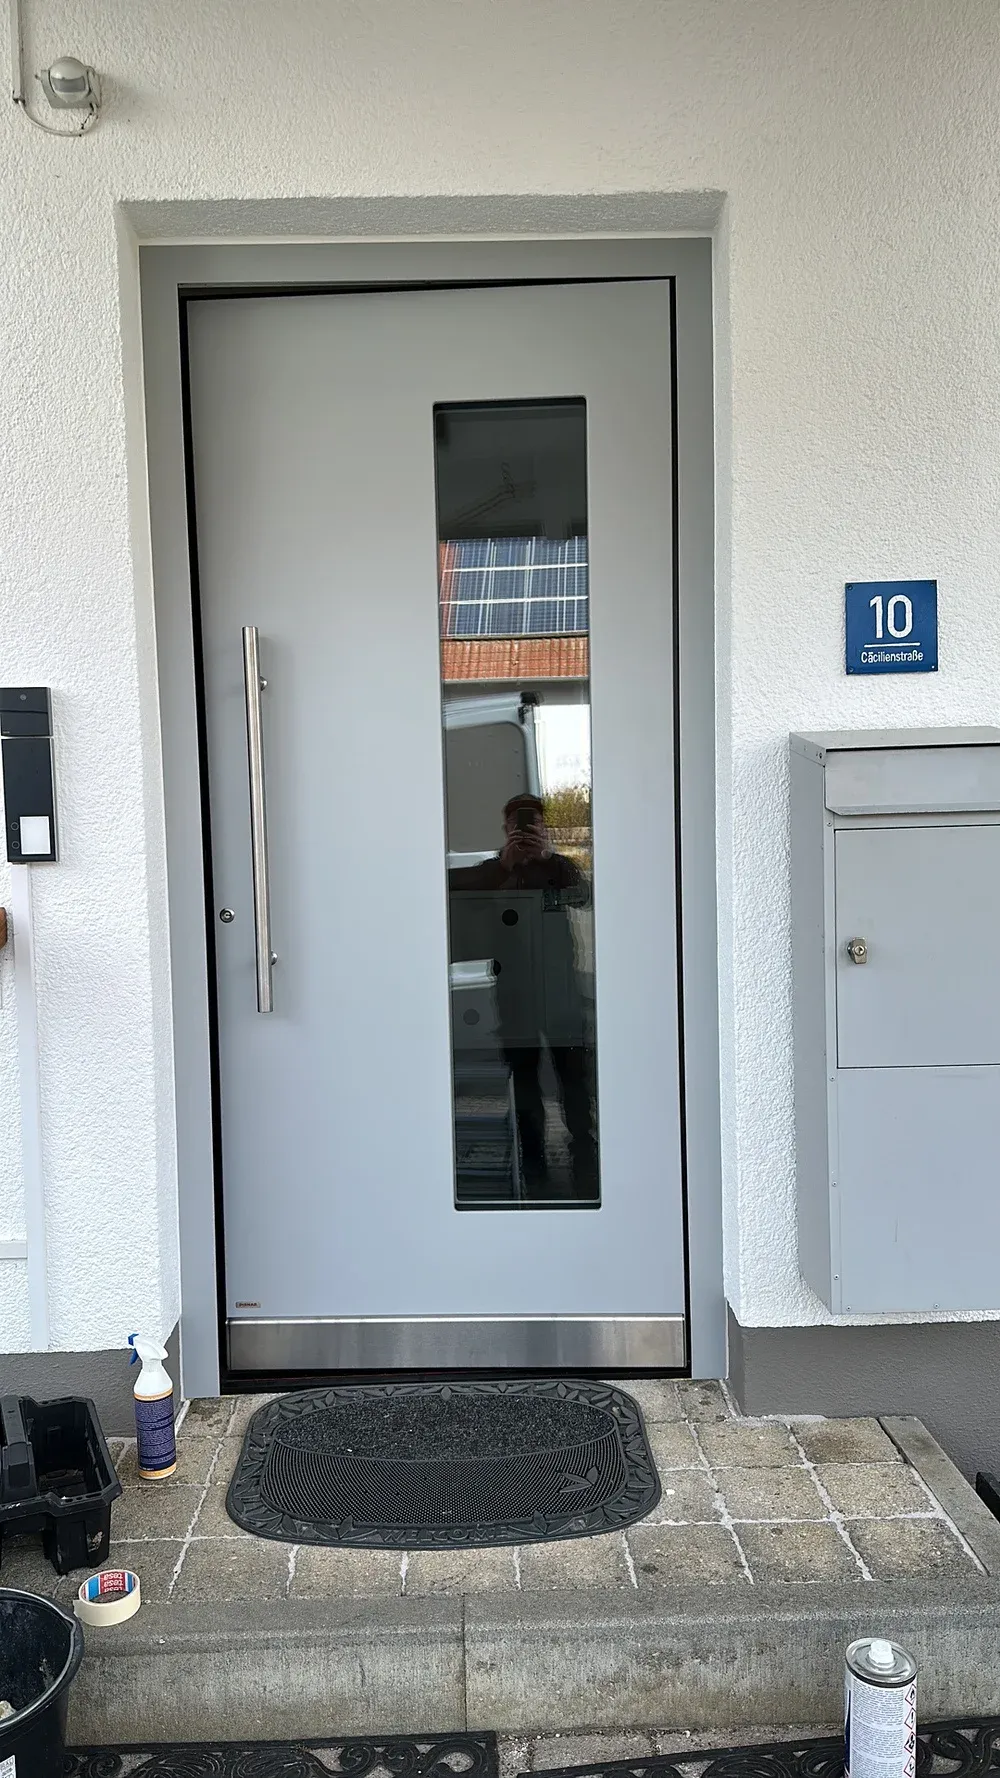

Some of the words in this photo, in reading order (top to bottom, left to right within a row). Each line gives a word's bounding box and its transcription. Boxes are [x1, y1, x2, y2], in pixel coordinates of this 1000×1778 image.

[870, 594, 913, 639] 10
[861, 649, 924, 664] Cäcilienstraße
[381, 1525, 509, 1542] WELCOME
[103, 1572, 124, 1580] tesa
[103, 1579, 124, 1588] tesa
